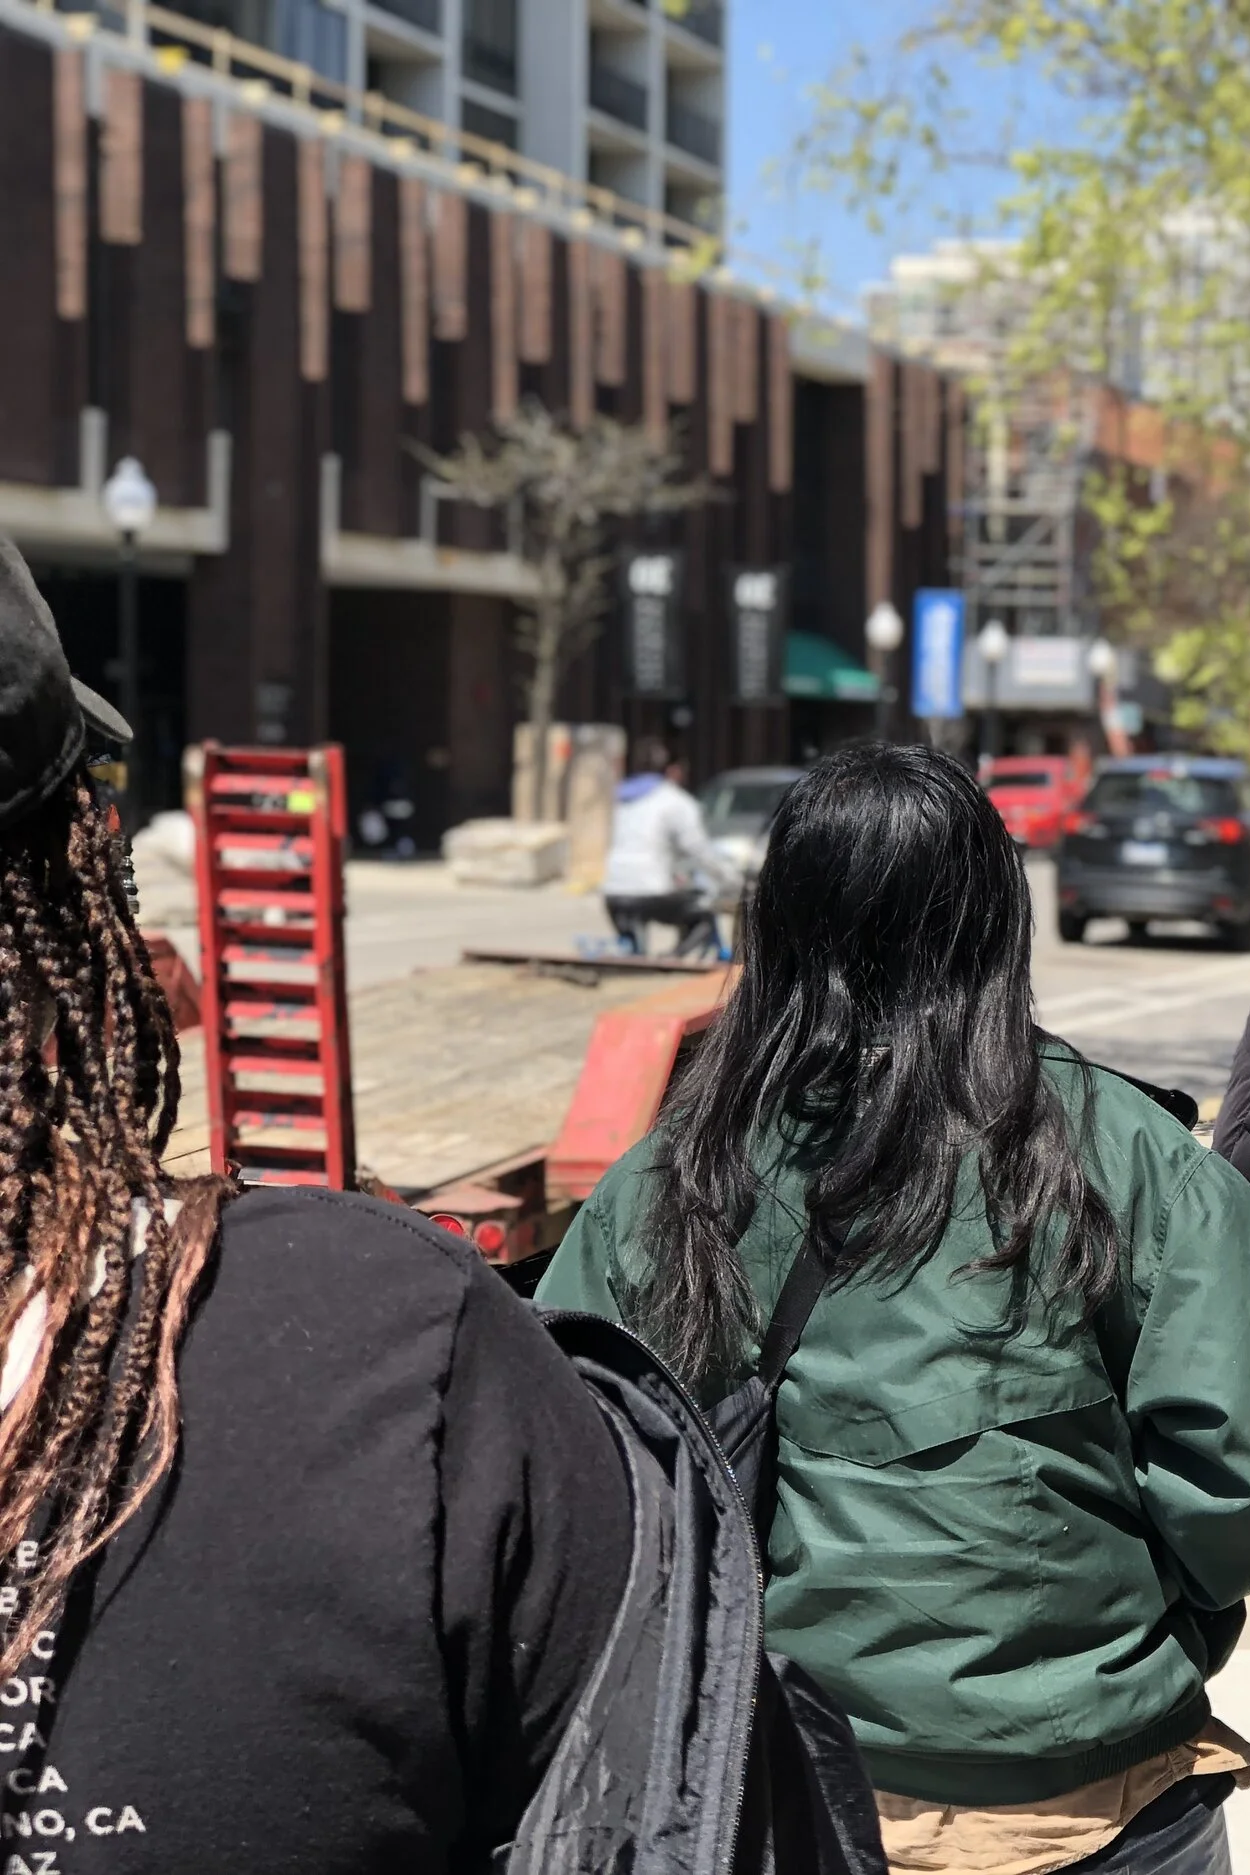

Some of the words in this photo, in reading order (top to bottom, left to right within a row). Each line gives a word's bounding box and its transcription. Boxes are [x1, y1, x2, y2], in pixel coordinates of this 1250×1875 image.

[1, 1676, 56, 1706] OR
[0, 1722, 47, 1752] CA
[8, 1765, 68, 1794] CA
[0, 1808, 76, 1842] NO,
[84, 1805, 146, 1836] CA
[7, 1851, 61, 1875] AZ
